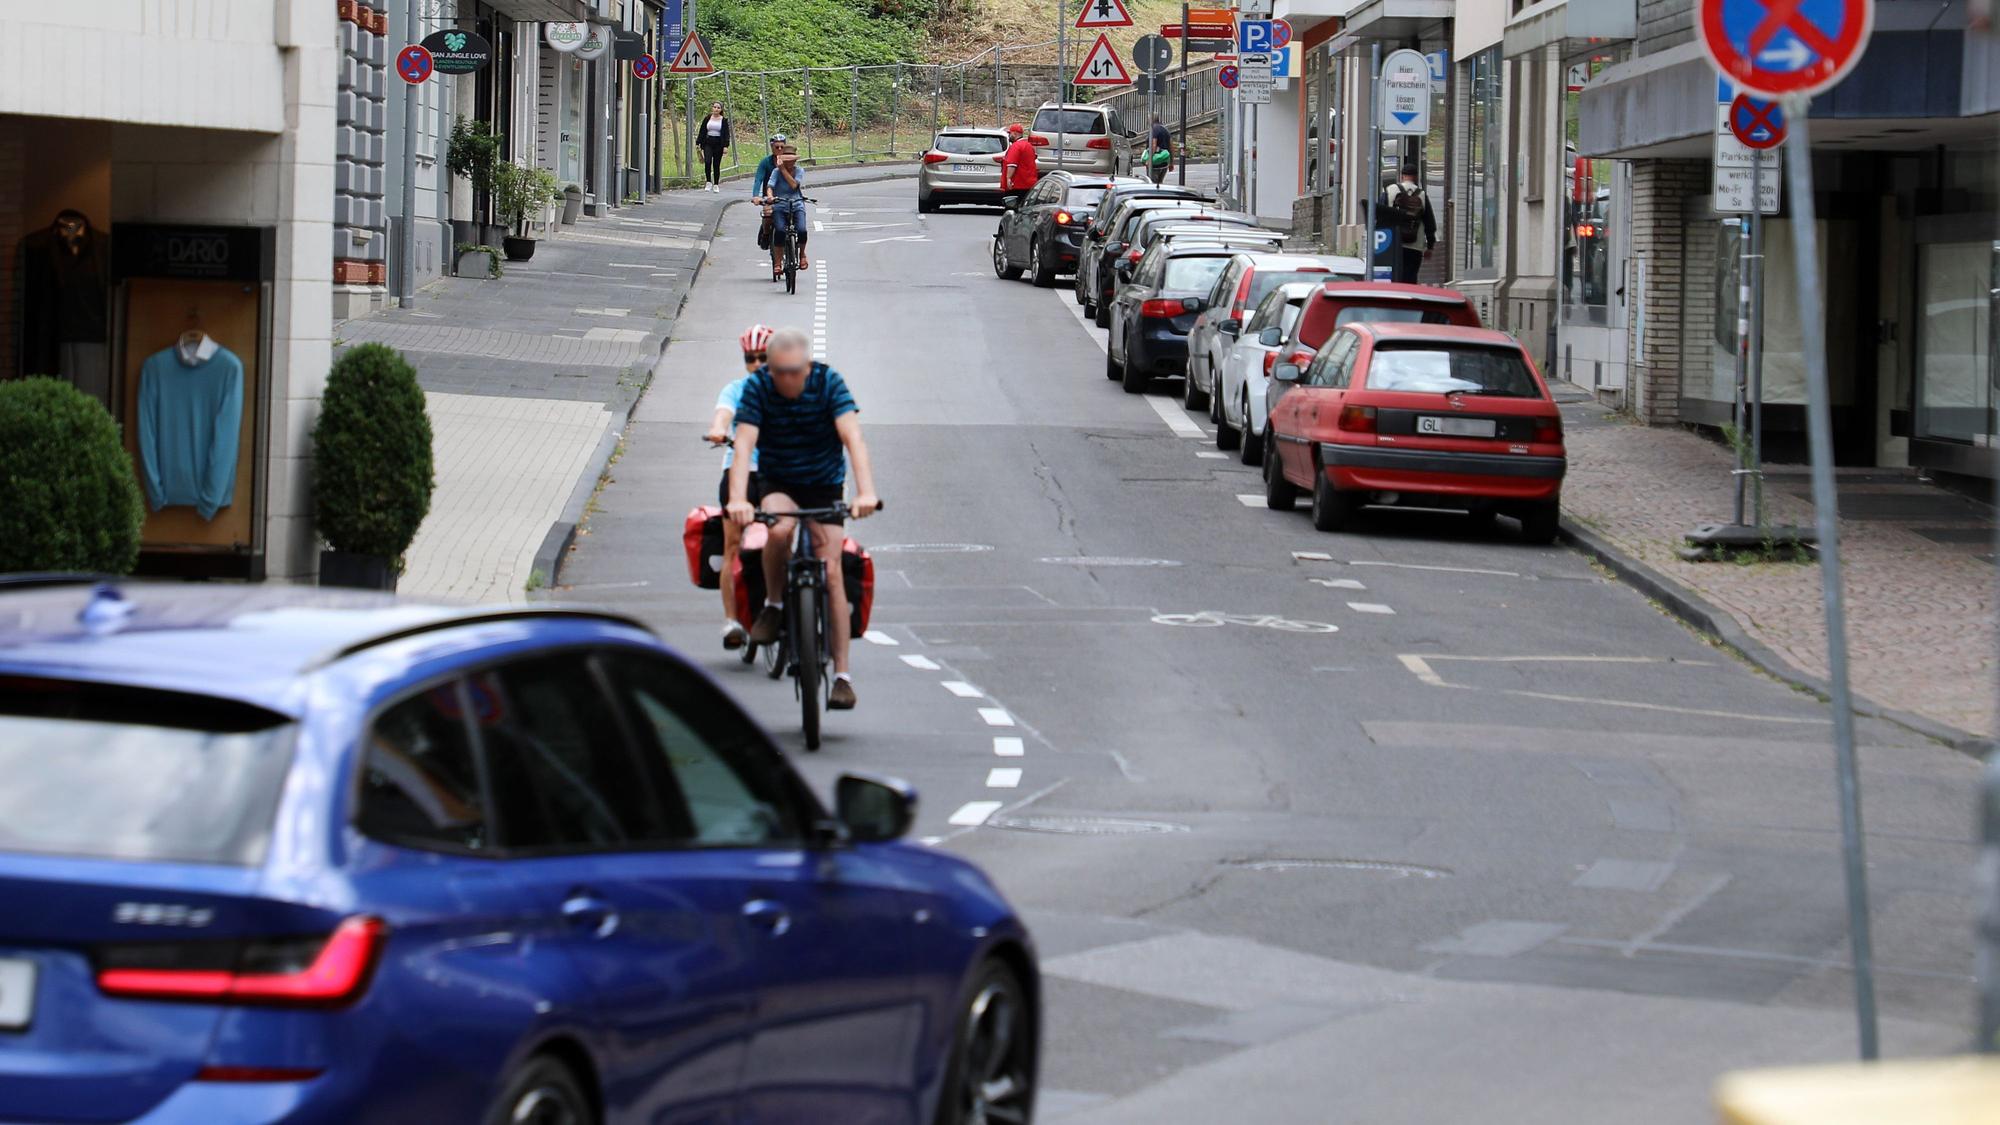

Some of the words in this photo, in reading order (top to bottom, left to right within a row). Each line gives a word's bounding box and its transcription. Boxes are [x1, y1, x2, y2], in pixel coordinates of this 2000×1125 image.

[1247, 24, 1265, 49] P
[1399, 65, 1414, 73] Hier
[1387, 79, 1426, 89] Parkschein
[1396, 94, 1416, 104] lösen
[1720, 152, 1776, 161] Parkscein
[1729, 171, 1766, 180] werkts
[1718, 185, 1742, 194] Mo-Fr
[1732, 197, 1742, 207] Sa
[1374, 231, 1387, 250] P
[168, 238, 229, 263] DARIO
[1423, 419, 1440, 432] GL
